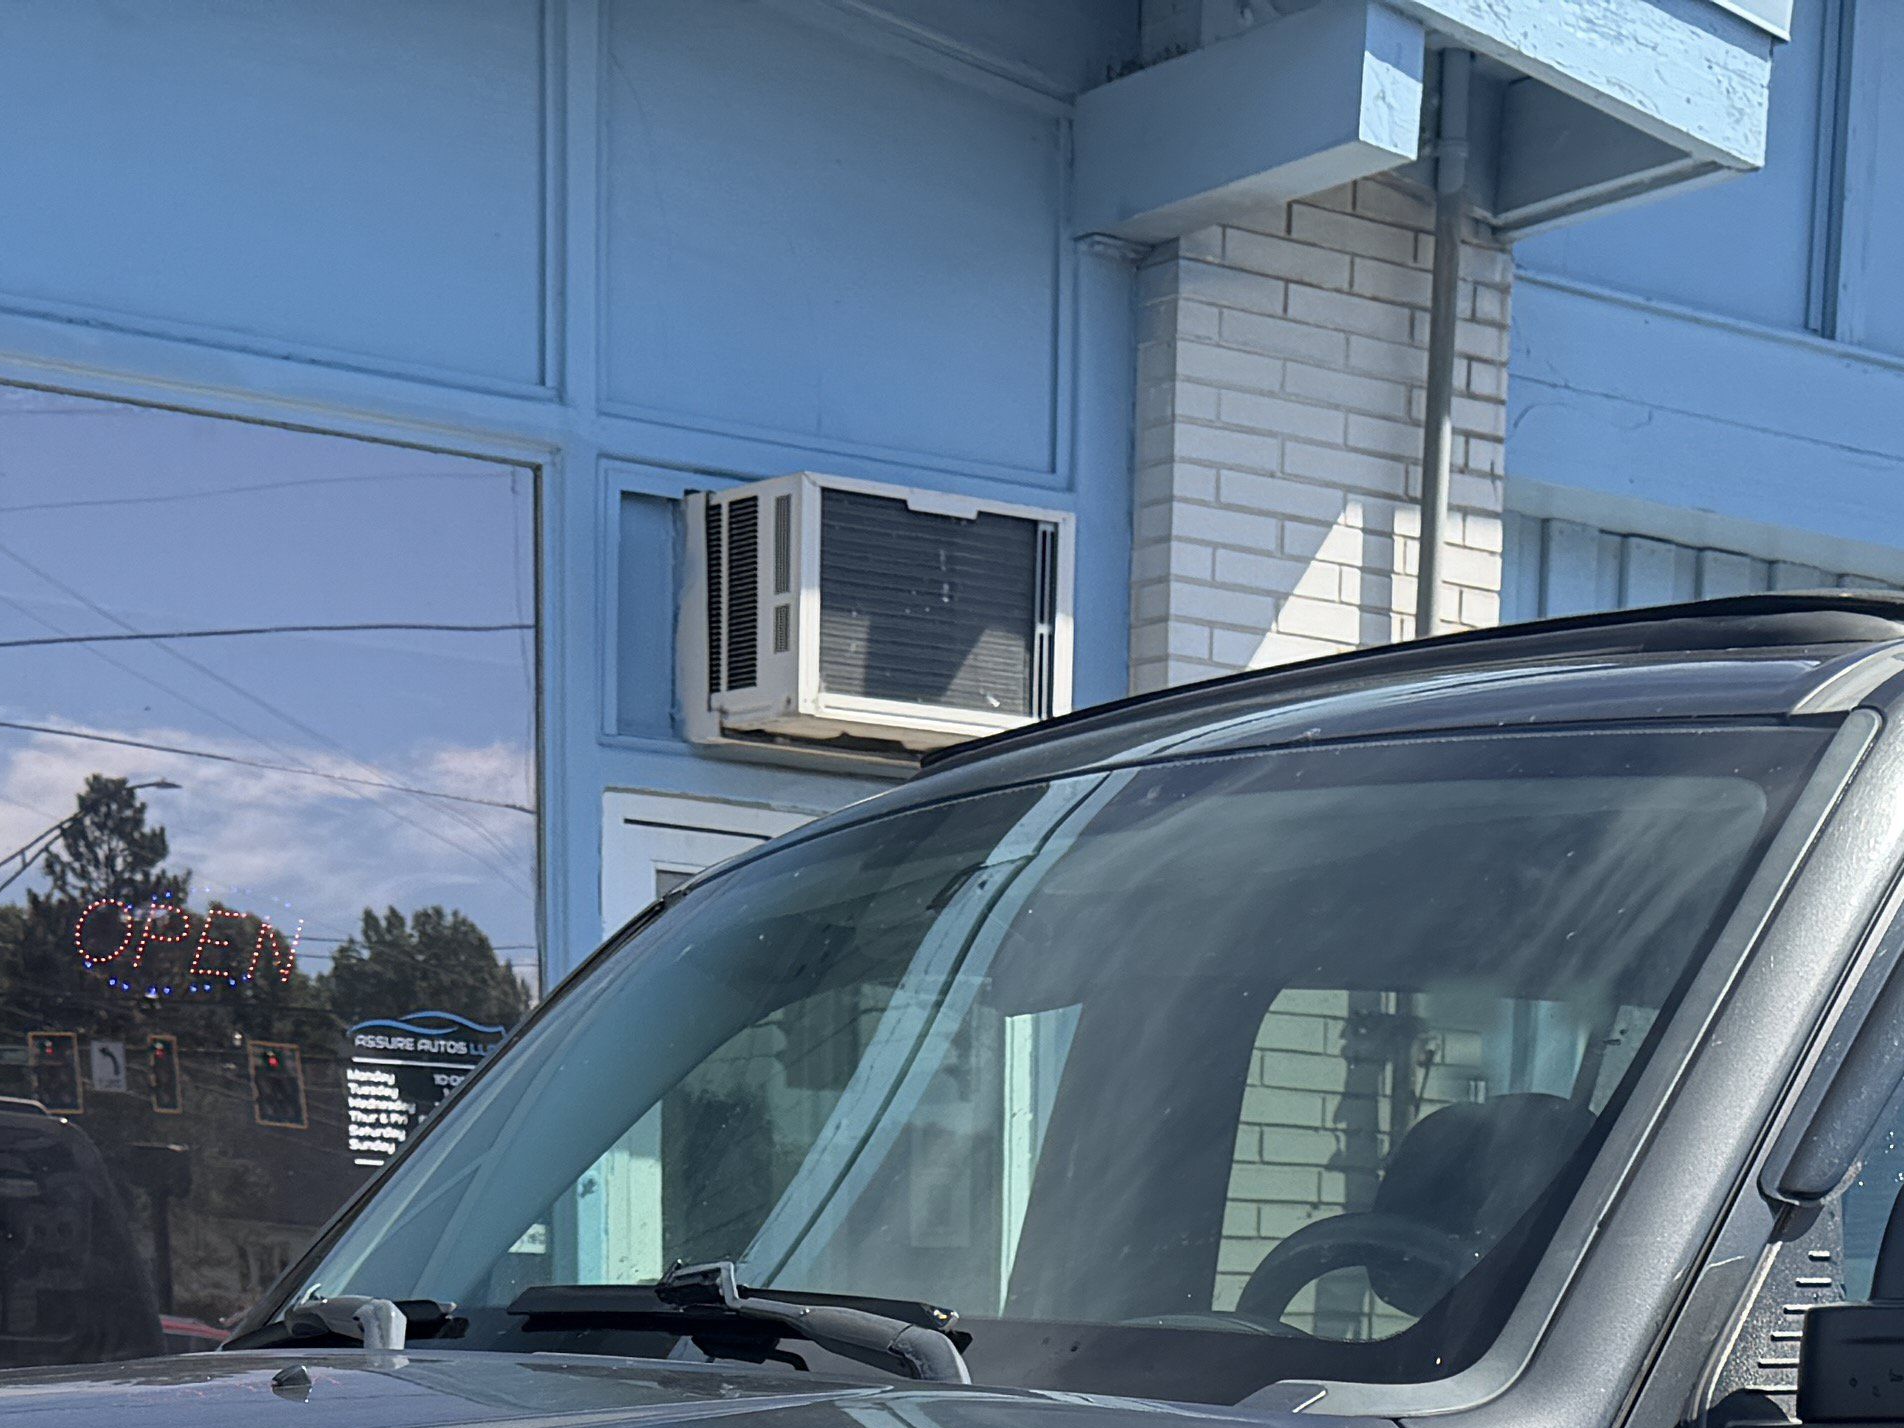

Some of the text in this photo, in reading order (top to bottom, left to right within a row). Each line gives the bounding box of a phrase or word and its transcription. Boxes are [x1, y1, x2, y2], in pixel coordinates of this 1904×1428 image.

[74, 897, 304, 985] OPEN
[354, 1034, 415, 1051] ASSURE
[417, 1038, 467, 1055] AUTOS
[346, 1069, 396, 1086] Monday
[347, 1082, 400, 1100] Tuesday
[347, 1096, 417, 1114] Wednesday
[348, 1124, 407, 1142] Saturday
[348, 1138, 396, 1155] Sunday
